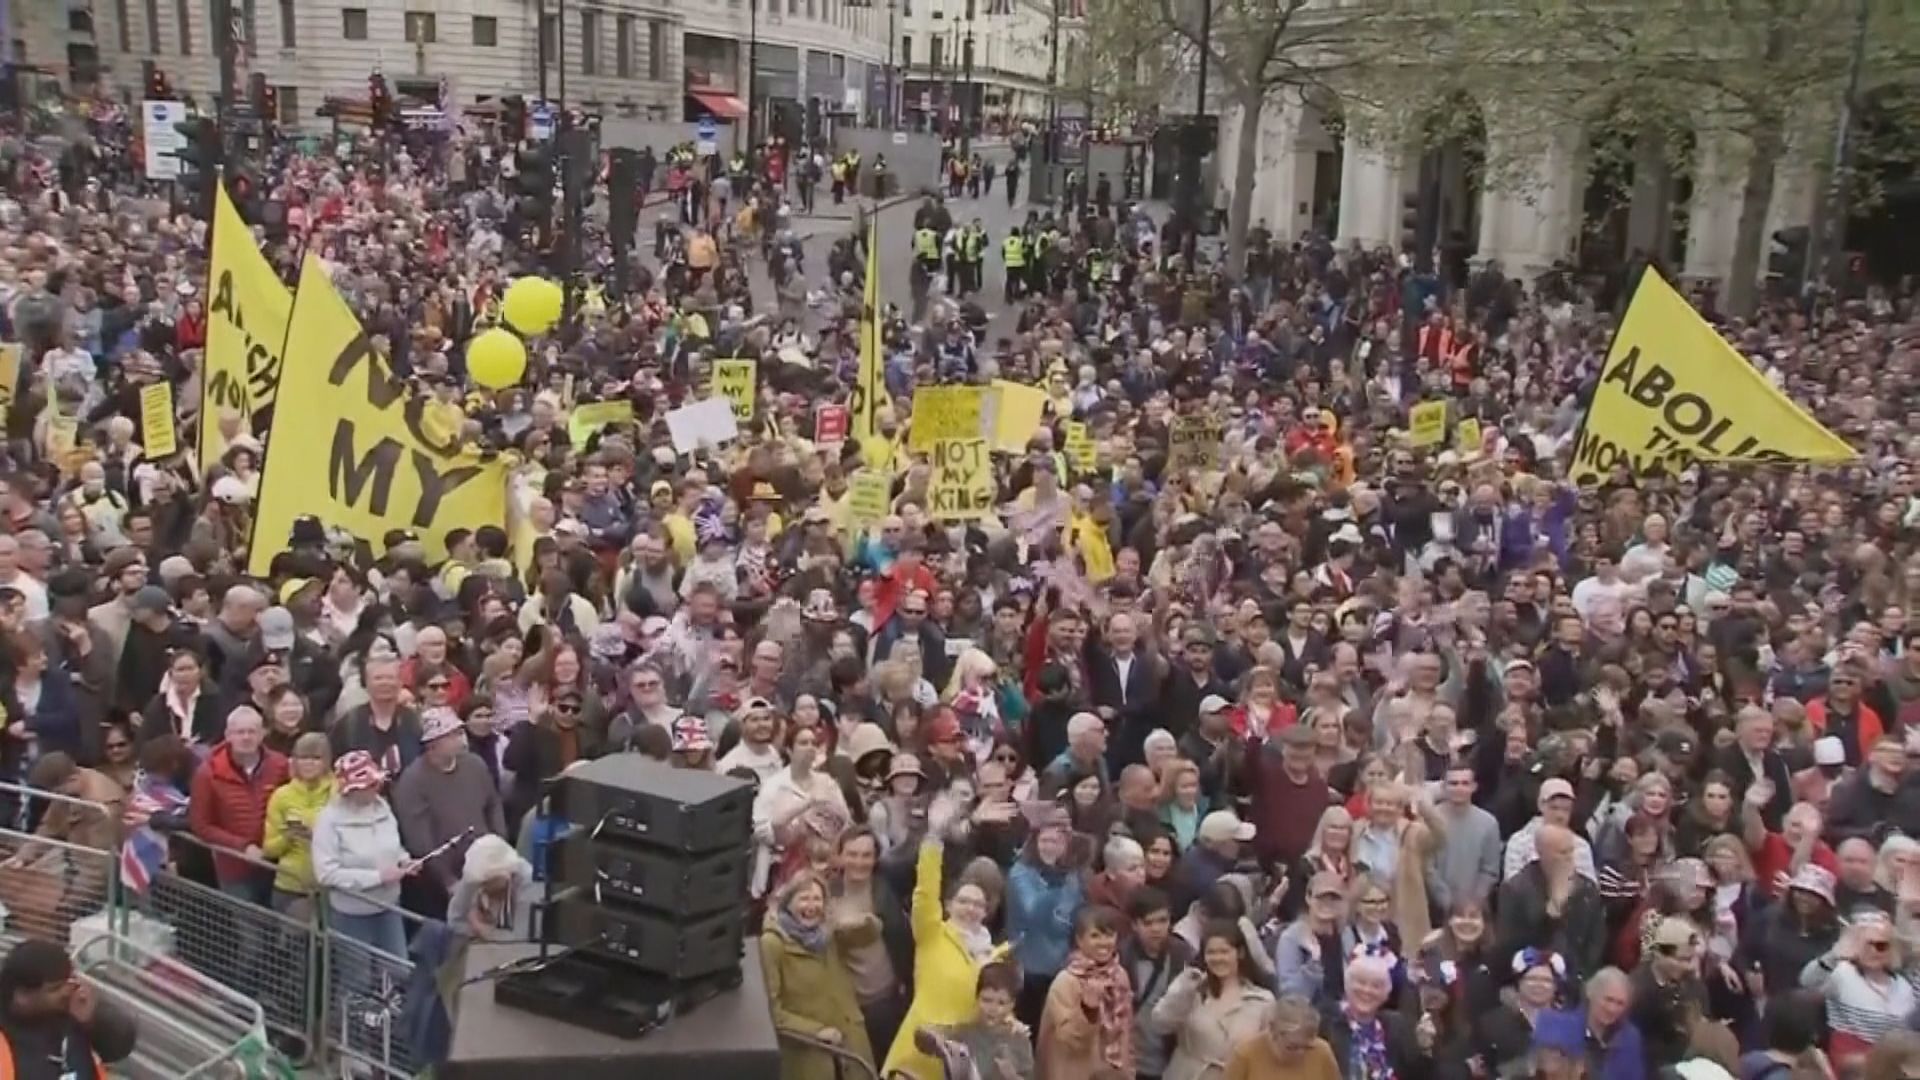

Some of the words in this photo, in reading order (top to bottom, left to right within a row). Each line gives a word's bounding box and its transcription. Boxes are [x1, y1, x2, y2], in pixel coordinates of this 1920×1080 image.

[719, 366, 750, 378] NT
[935, 440, 985, 468] NOT
[329, 418, 484, 528] MY
[942, 467, 976, 485] MY
